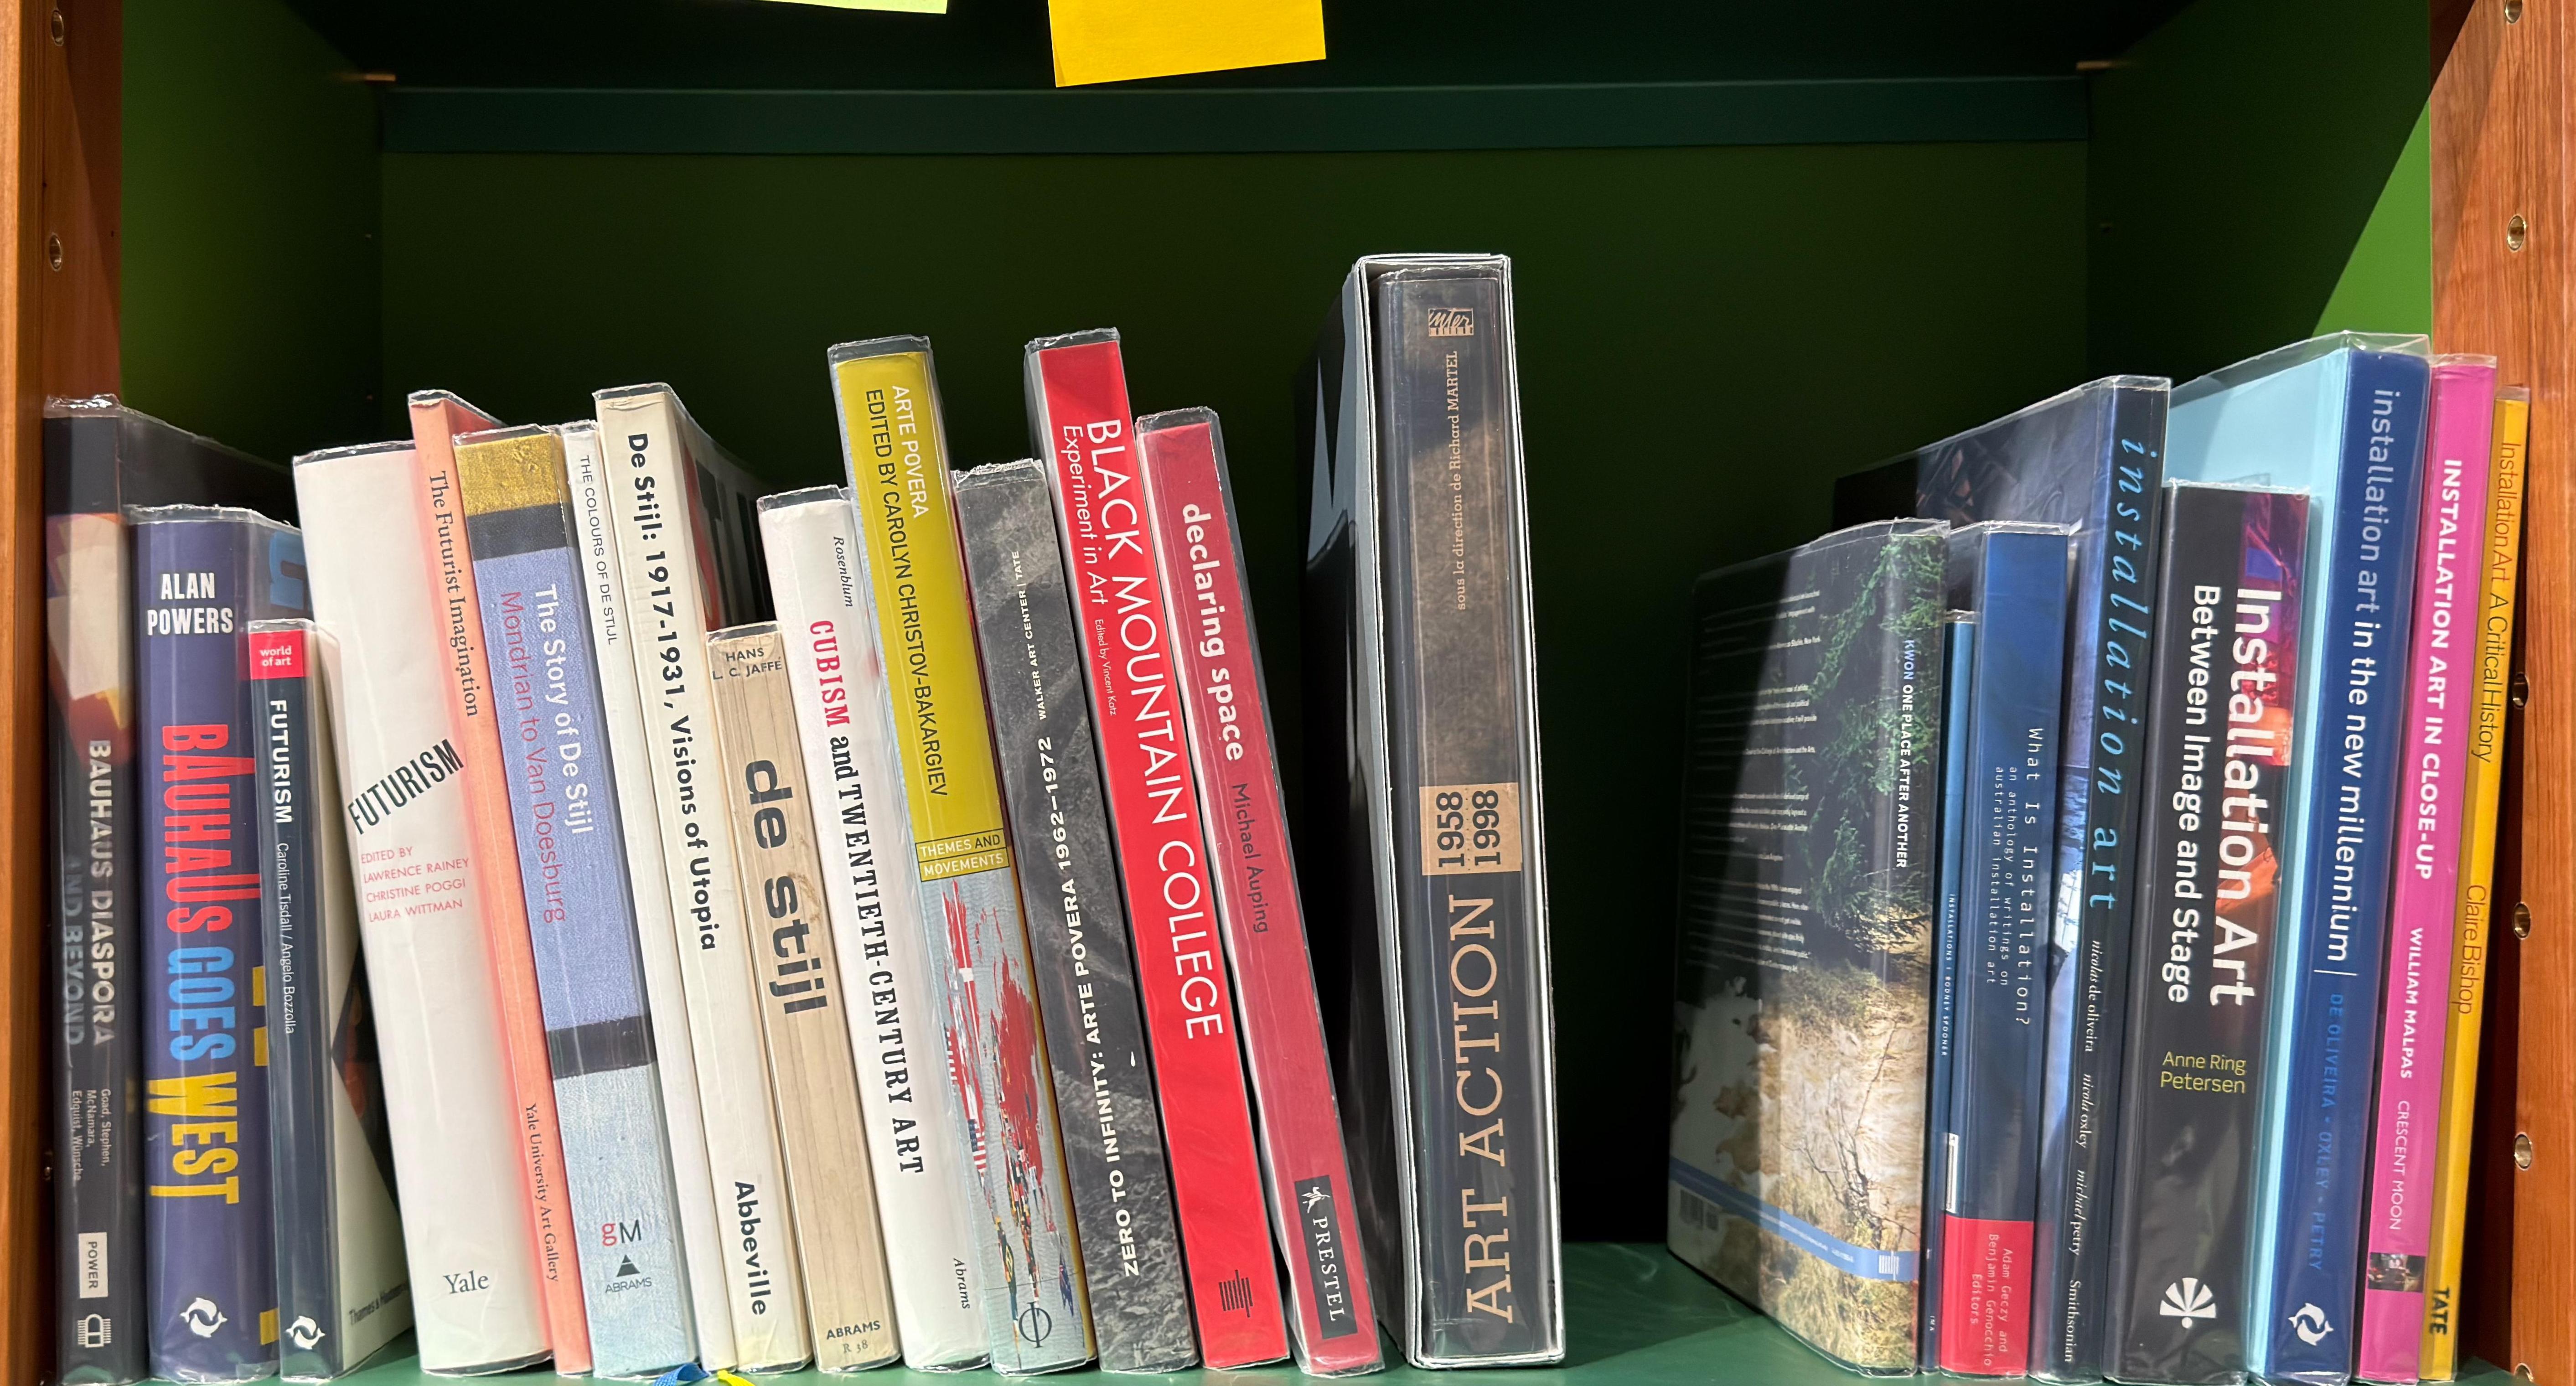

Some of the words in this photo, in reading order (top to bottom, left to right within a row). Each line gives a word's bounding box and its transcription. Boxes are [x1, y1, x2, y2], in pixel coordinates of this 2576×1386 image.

[892, 385, 917, 435] ARTE
[1446, 350, 1459, 412] MARTEL
[580, 455, 592, 483] THE
[628, 433, 649, 468] De
[1448, 415, 1460, 470] Richard
[429, 471, 445, 508] The
[901, 440, 929, 518] POVERA
[1061, 426, 1097, 540] Experiment
[1086, 419, 1143, 560] BLACK
[2360, 389, 2400, 561] installation
[2495, 442, 2522, 540] Installation
[585, 488, 604, 557] COLOURS
[634, 476, 663, 540] Stijl:
[1451, 494, 1464, 557] direction
[435, 512, 463, 593] Futurist
[833, 536, 853, 608] Rosenblum
[1011, 550, 1023, 580] TATE
[2430, 459, 2462, 649] INSTALLATION
[2493, 542, 2512, 583] Art
[161, 573, 215, 600] ALAN
[535, 584, 558, 633] The
[866, 389, 892, 458] EDITED
[883, 491, 912, 580] CAROLYN
[898, 584, 948, 796] CHRISTOV-BAKARGIEV
[1019, 589, 1033, 640] CENTER
[1087, 571, 1108, 605] Art
[1458, 577, 1466, 610] sous
[2097, 438, 2158, 795] installation
[2355, 570, 2379, 613] art
[147, 608, 233, 635] POWERS
[260, 646, 292, 657] world
[500, 591, 535, 711] Mondrian
[603, 607, 618, 645] STIJL
[645, 551, 686, 709] 1917-1931,
[1095, 619, 1108, 646] Edited
[2483, 616, 2509, 688] Critical
[275, 657, 291, 666] art
[449, 597, 478, 717] Imagination
[543, 639, 570, 706] Story
[725, 647, 765, 662] HANS
[745, 656, 783, 677] JAFFÉ
[1028, 643, 1038, 667] ART
[1102, 661, 1114, 694] Vincent
[1903, 640, 1915, 680] KWON
[2186, 585, 2220, 725] Between
[2427, 656, 2448, 710] ART
[1031, 670, 1046, 720] WALKER
[1107, 695, 1117, 716] Katz
[1112, 576, 1187, 825] MOUNTAIN
[1182, 503, 1226, 658] declaring
[1207, 667, 1244, 761] space
[1232, 783, 1261, 861] Michael
[1247, 865, 1269, 934] Auping
[1902, 684, 1914, 711] ONE
[2471, 688, 2502, 764] History
[270, 700, 292, 823] FUTURISM
[559, 742, 582, 777] De
[669, 714, 697, 816] Visions
[1900, 714, 1912, 756] PLACE
[2026, 728, 2043, 781] What
[2218, 588, 2281, 901] Installation
[2342, 714, 2366, 779] new
[347, 739, 464, 835] FUTURISM
[525, 747, 547, 794] Van
[1898, 760, 1911, 800] AFTER
[2173, 735, 2211, 832] Image
[89, 740, 114, 879] BAUHAUS
[163, 724, 261, 933] BAUHAUS
[564, 783, 594, 835] Stijl
[745, 760, 793, 850] de
[1436, 789, 1466, 868] 1958
[1472, 788, 1502, 866] 1998
[1895, 803, 1910, 868] ANOTHER
[1992, 766, 2004, 846] australian
[2003, 791, 2017, 863] anthology
[2414, 752, 2440, 880] CLOSE-UP
[276, 843, 290, 890] Caroline
[361, 849, 395, 864] EDITED
[363, 864, 422, 884] LAWRENCE
[427, 858, 470, 874] RAINEY
[533, 802, 566, 924] Doesburg
[920, 838, 972, 858] THEMES
[923, 853, 1004, 877] MOVEMENTS
[2089, 827, 2119, 910] art
[2327, 785, 2365, 962] millennium
[279, 893, 292, 931] Tisdall
[366, 885, 421, 903] CHRISTINE
[425, 878, 466, 892] POGGI
[369, 909, 401, 922] LAURA
[405, 899, 463, 916] WITTMAN
[688, 857, 721, 951] Utopia
[810, 621, 851, 728] CUBISM
[838, 784, 912, 1103] TWENTIETH-CENTURY
[892, 1117, 925, 1174] ART
[1988, 857, 2001, 951] installation
[2464, 884, 2487, 943] Claire
[765, 875, 828, 1014] stijl
[1061, 878, 1091, 977] POVERA
[1158, 840, 1224, 1040] COLLEGE
[1946, 894, 1955, 961] INSTALLATIONS
[2000, 897, 2012, 961] writings
[2016, 846, 2039, 1025] Installation?
[2162, 908, 2199, 1003] Stage
[63, 926, 84, 1046] BEYOND
[91, 890, 115, 1046] DIASPORA
[279, 942, 294, 983] Angelo
[1986, 962, 1995, 984] art
[2210, 915, 2258, 1006] Art
[2405, 927, 2424, 1005] WILLIAM
[2451, 944, 2483, 1015] Bishop
[168, 947, 235, 1062] GOES
[283, 986, 296, 1034] Bozzolla
[1078, 983, 1101, 1044] ARTE
[1448, 894, 1507, 1168] ACTION
[2085, 1004, 2101, 1052] oliveira
[2162, 1051, 2206, 1070] Anne
[2209, 1054, 2247, 1076] Ring
[2321, 1024, 2341, 1108] OLIVEIRA
[2400, 1009, 2417, 1080] MALPAS
[101, 1089, 111, 1117] Goad,
[1090, 1052, 1120, 1161] INFINITY:
[2081, 1073, 2095, 1112] nicola
[2160, 1072, 2245, 1094] Petersen
[85, 1090, 97, 1147] McNamara,
[100, 1121, 112, 1166] Stephen,
[146, 1071, 239, 1205] WEST
[525, 1103, 537, 1130] Yale
[2075, 1114, 2092, 1149] oxley
[2393, 1099, 2410, 1176] CRESCENT
[530, 1133, 548, 1203] University
[540, 1206, 553, 1231] Art
[2389, 1180, 2404, 1231] MOON
[88, 1241, 98, 1290] POWER
[544, 1234, 559, 1283] Gallery
[734, 1181, 771, 1316] Abbeville
[1115, 1209, 1139, 1277] ZERO
[1462, 1188, 1513, 1324] ART
[1986, 1233, 1998, 1293] Benjamin
[2002, 1248, 2013, 1277] Adam
[2068, 1220, 2083, 1256] petry
[443, 1271, 489, 1294] Yale
[605, 1277, 652, 1294] ABRAMS
[953, 1257, 971, 1310] Abrams
[1312, 1217, 1345, 1322] PRESTEL
[1969, 1273, 1983, 1324] Editors
[826, 1320, 881, 1340] ABRAMS
[1983, 1299, 1996, 1366] Genocchio
[1997, 1283, 2011, 1321] Geczy
[2064, 1279, 2081, 1362] Smithsonian
[2429, 1287, 2450, 1335] TATE
